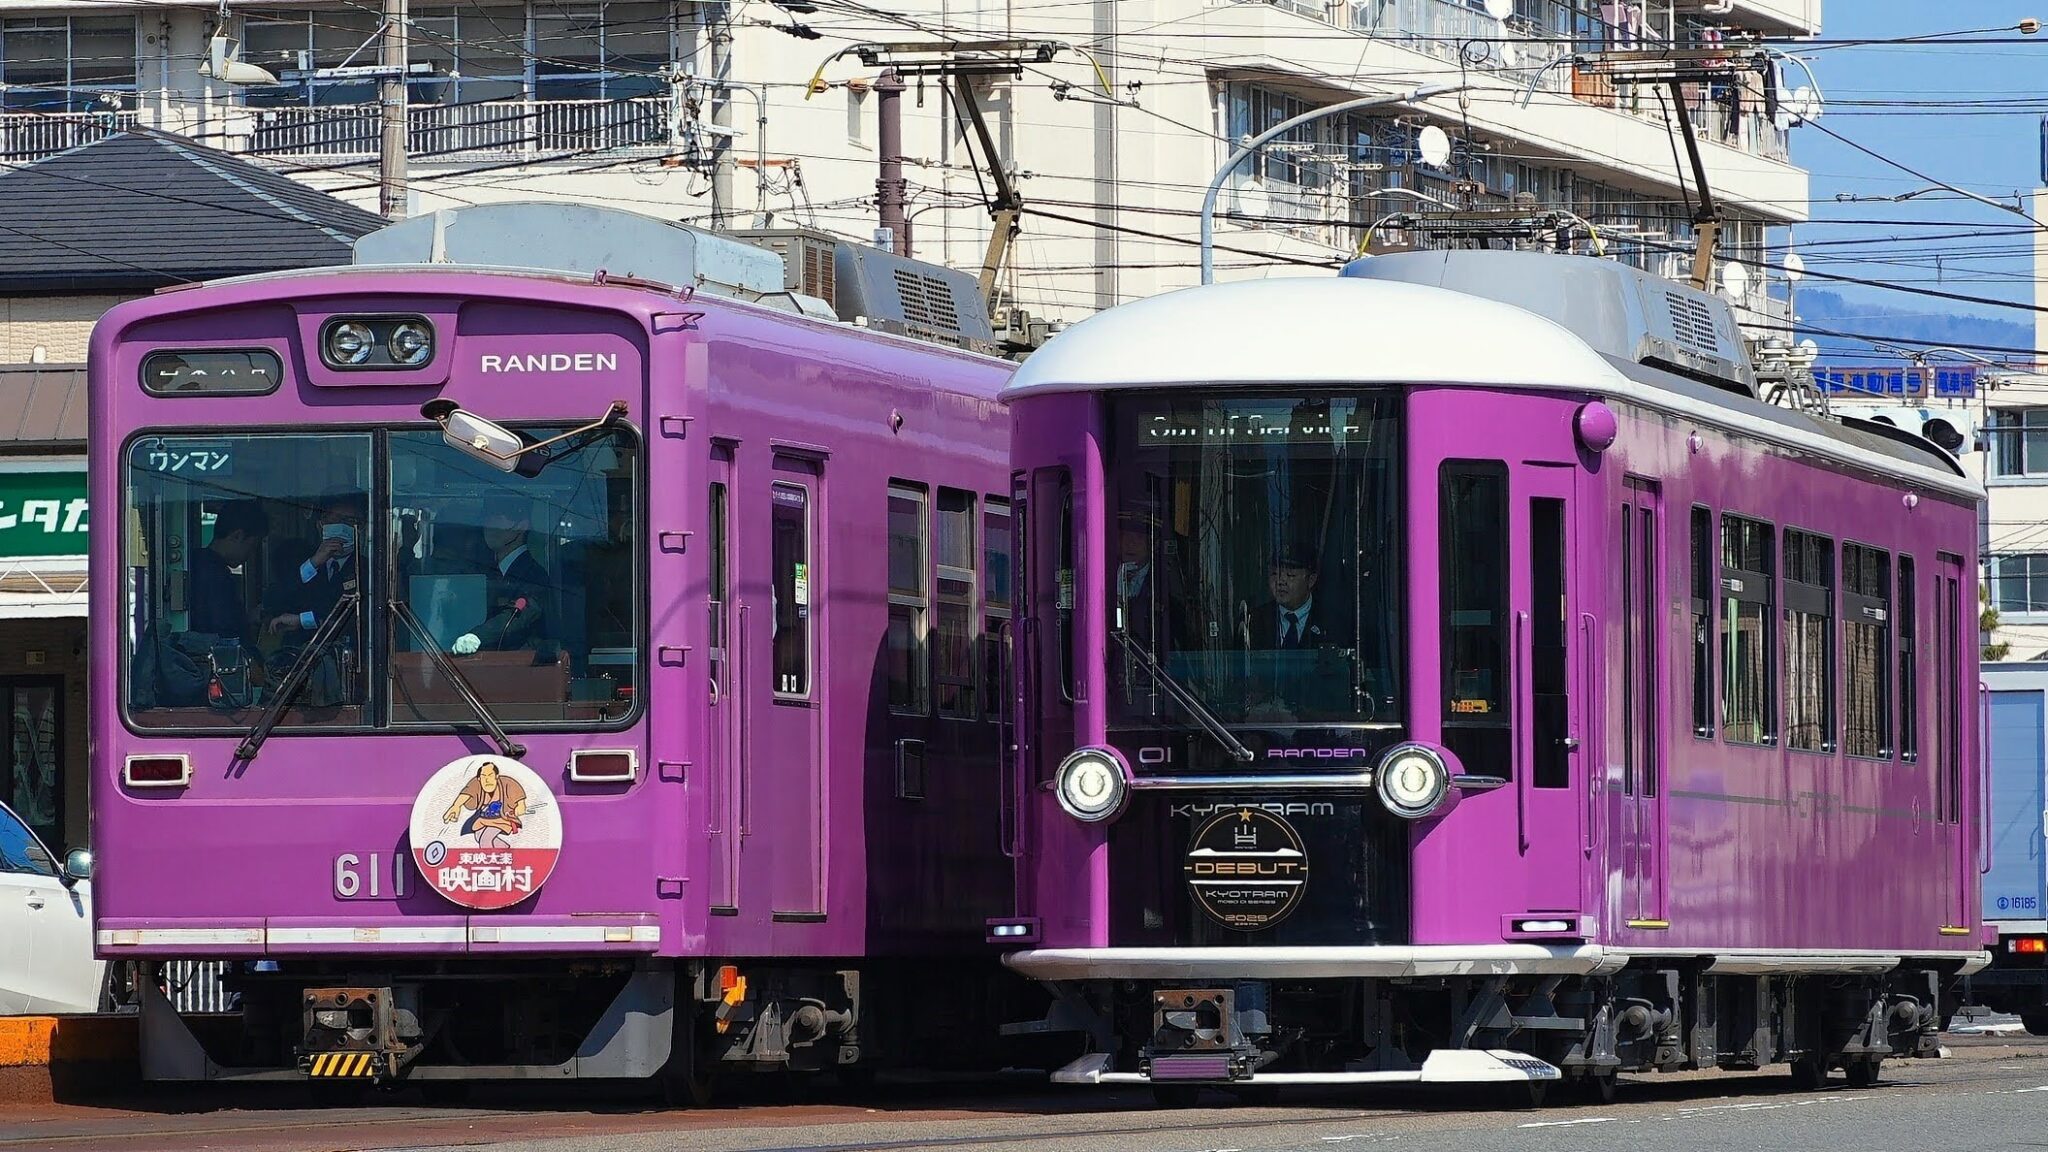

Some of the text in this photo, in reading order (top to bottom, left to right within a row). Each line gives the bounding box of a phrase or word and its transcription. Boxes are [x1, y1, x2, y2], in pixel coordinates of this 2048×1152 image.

[481, 353, 617, 373] RANDEN
[149, 451, 229, 471] ワンマン
[1267, 748, 1366, 758] RANDEN
[1170, 803, 1334, 817] KYRAM
[458, 853, 513, 865] 東映太秦
[1195, 863, 1298, 874] DEBUT
[336, 853, 404, 897] 611
[438, 866, 533, 892] 映画村
[1206, 890, 1288, 898] KYOTRAM
[2011, 897, 2037, 909] 16185
[1225, 914, 1268, 922] 2025
